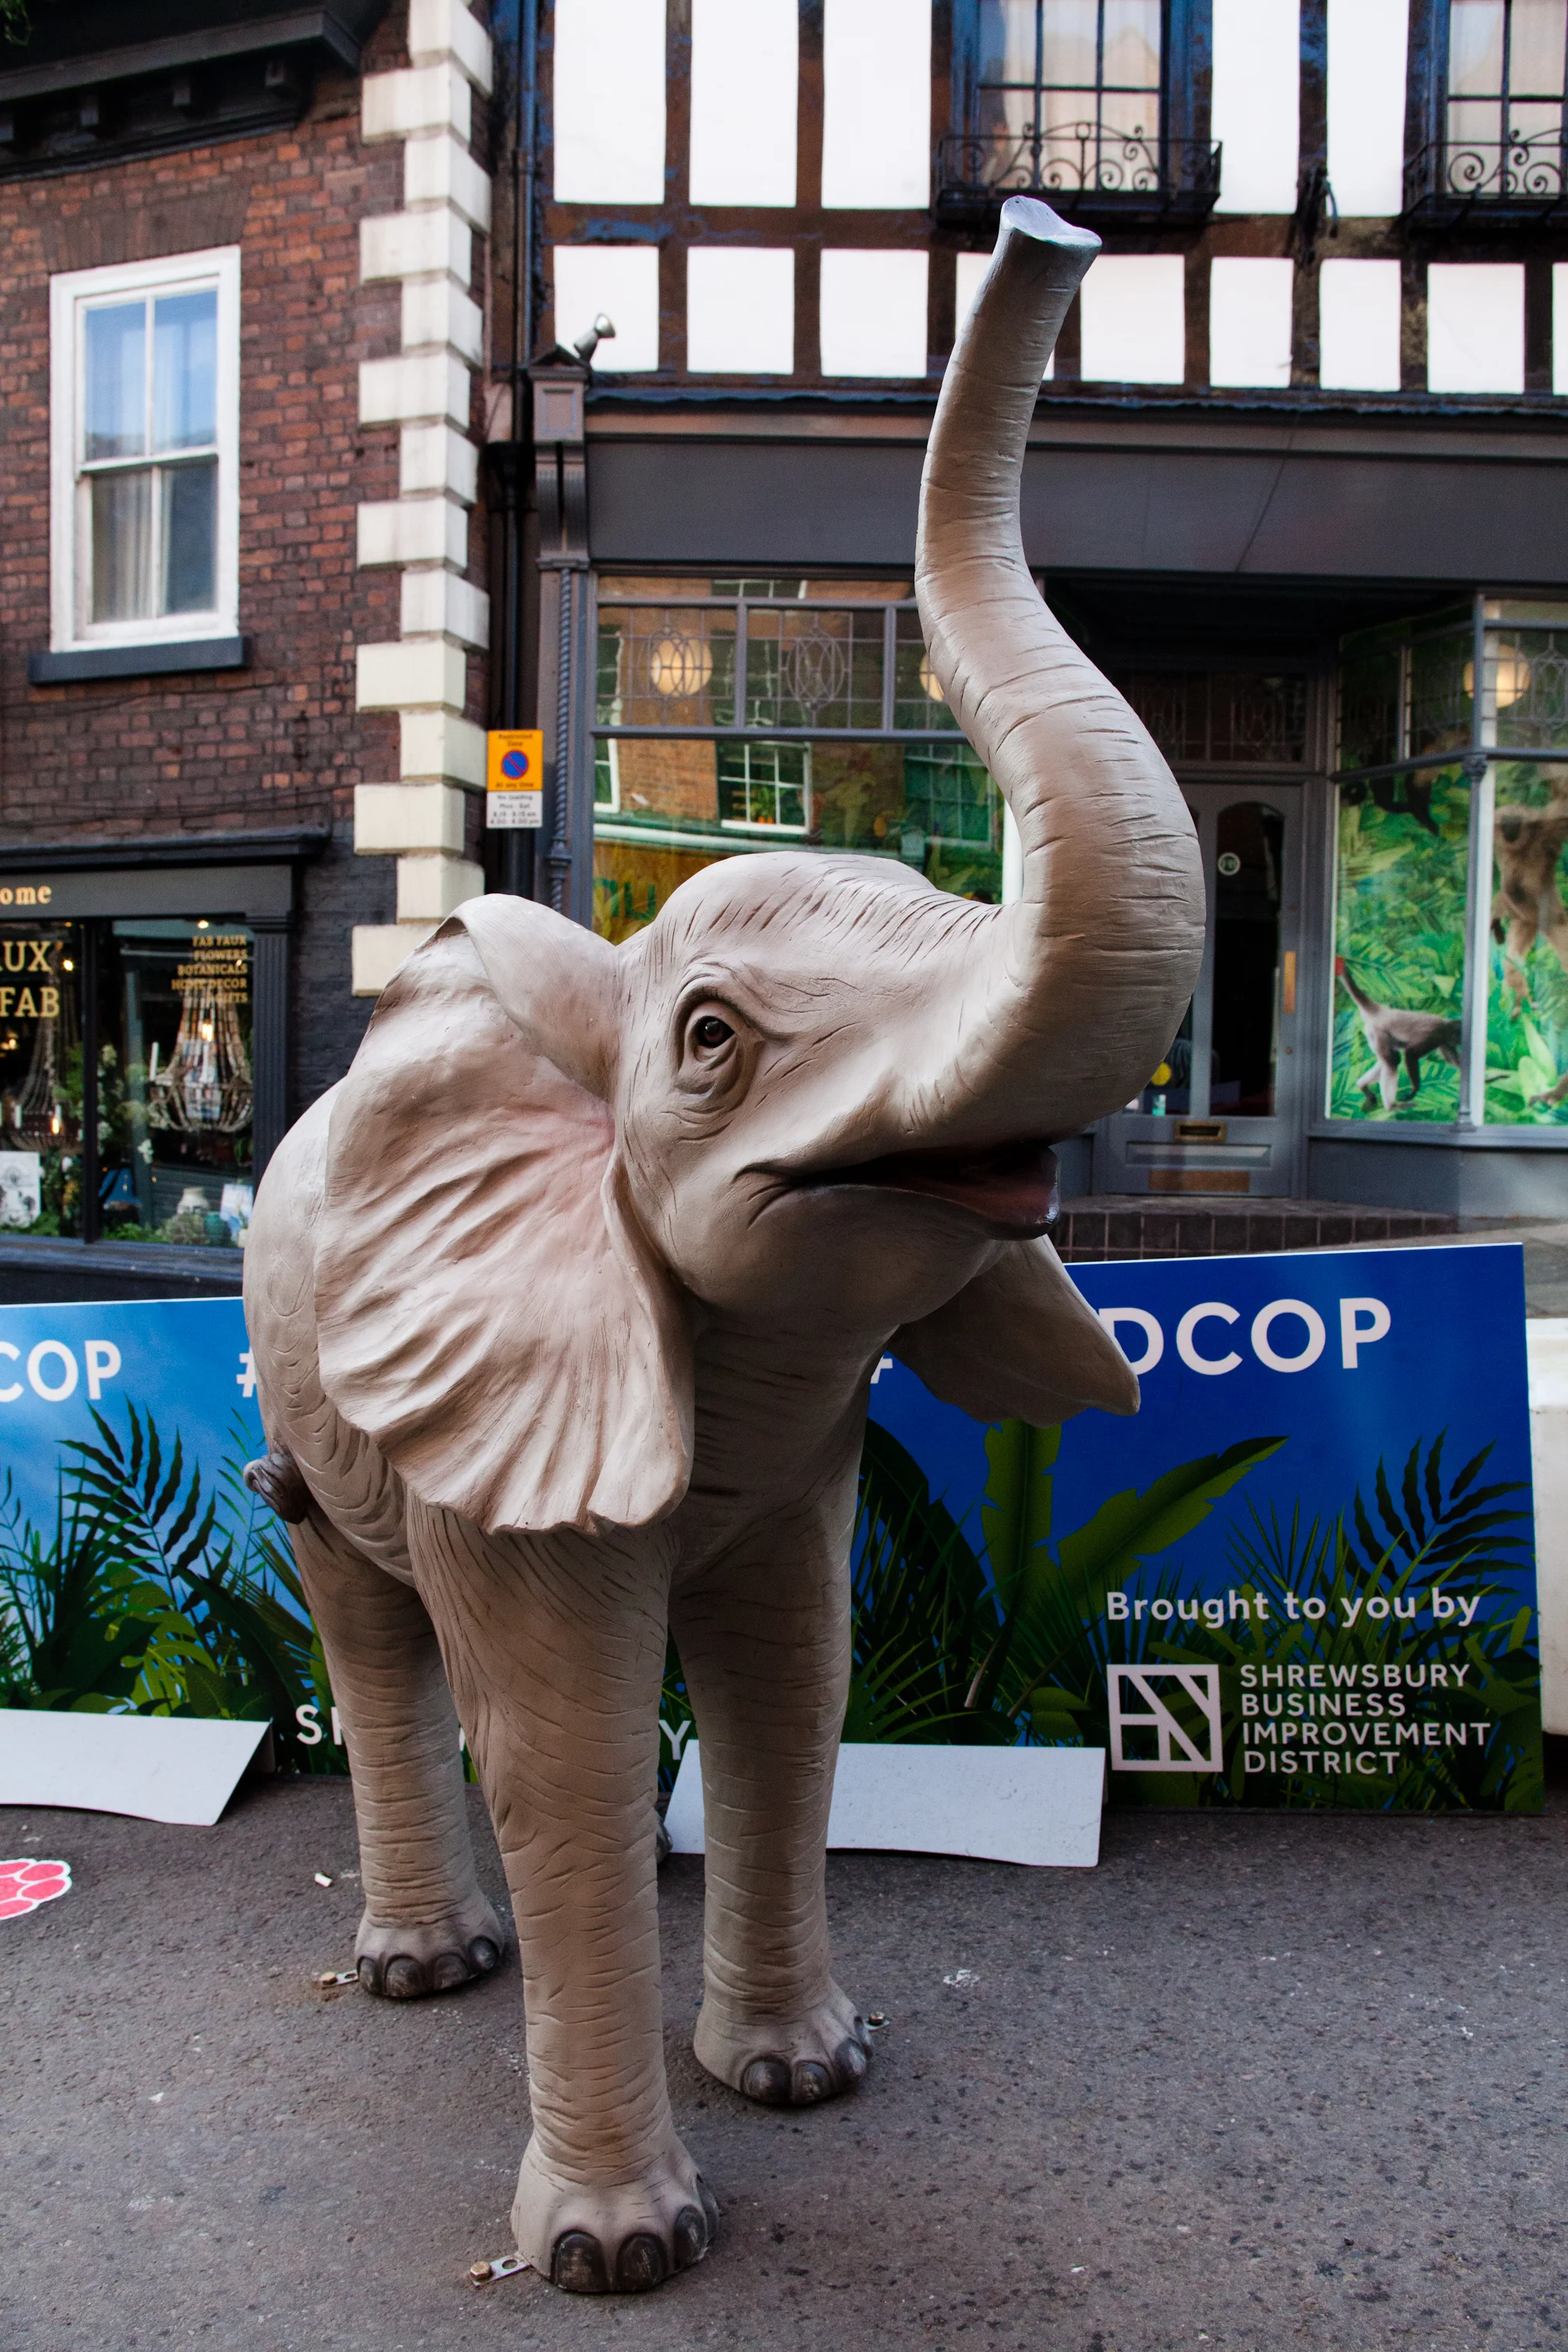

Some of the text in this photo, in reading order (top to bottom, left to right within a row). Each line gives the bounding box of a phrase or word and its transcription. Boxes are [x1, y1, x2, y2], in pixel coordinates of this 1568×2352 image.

[216, 934, 247, 946] FAUX
[0, 940, 52, 973] UX
[193, 948, 248, 962] FLOWERS
[177, 963, 248, 977] BOTANICALS
[0, 986, 61, 1018] FAB
[1106, 1588, 1481, 1629] Brought to you by
[1240, 1663, 1470, 1688] SHREWSBURY
[1240, 1693, 1406, 1716] BUSINESS
[1243, 1722, 1492, 1746] IMPROVEMENT
[1243, 1751, 1401, 1775] DISTRICT
